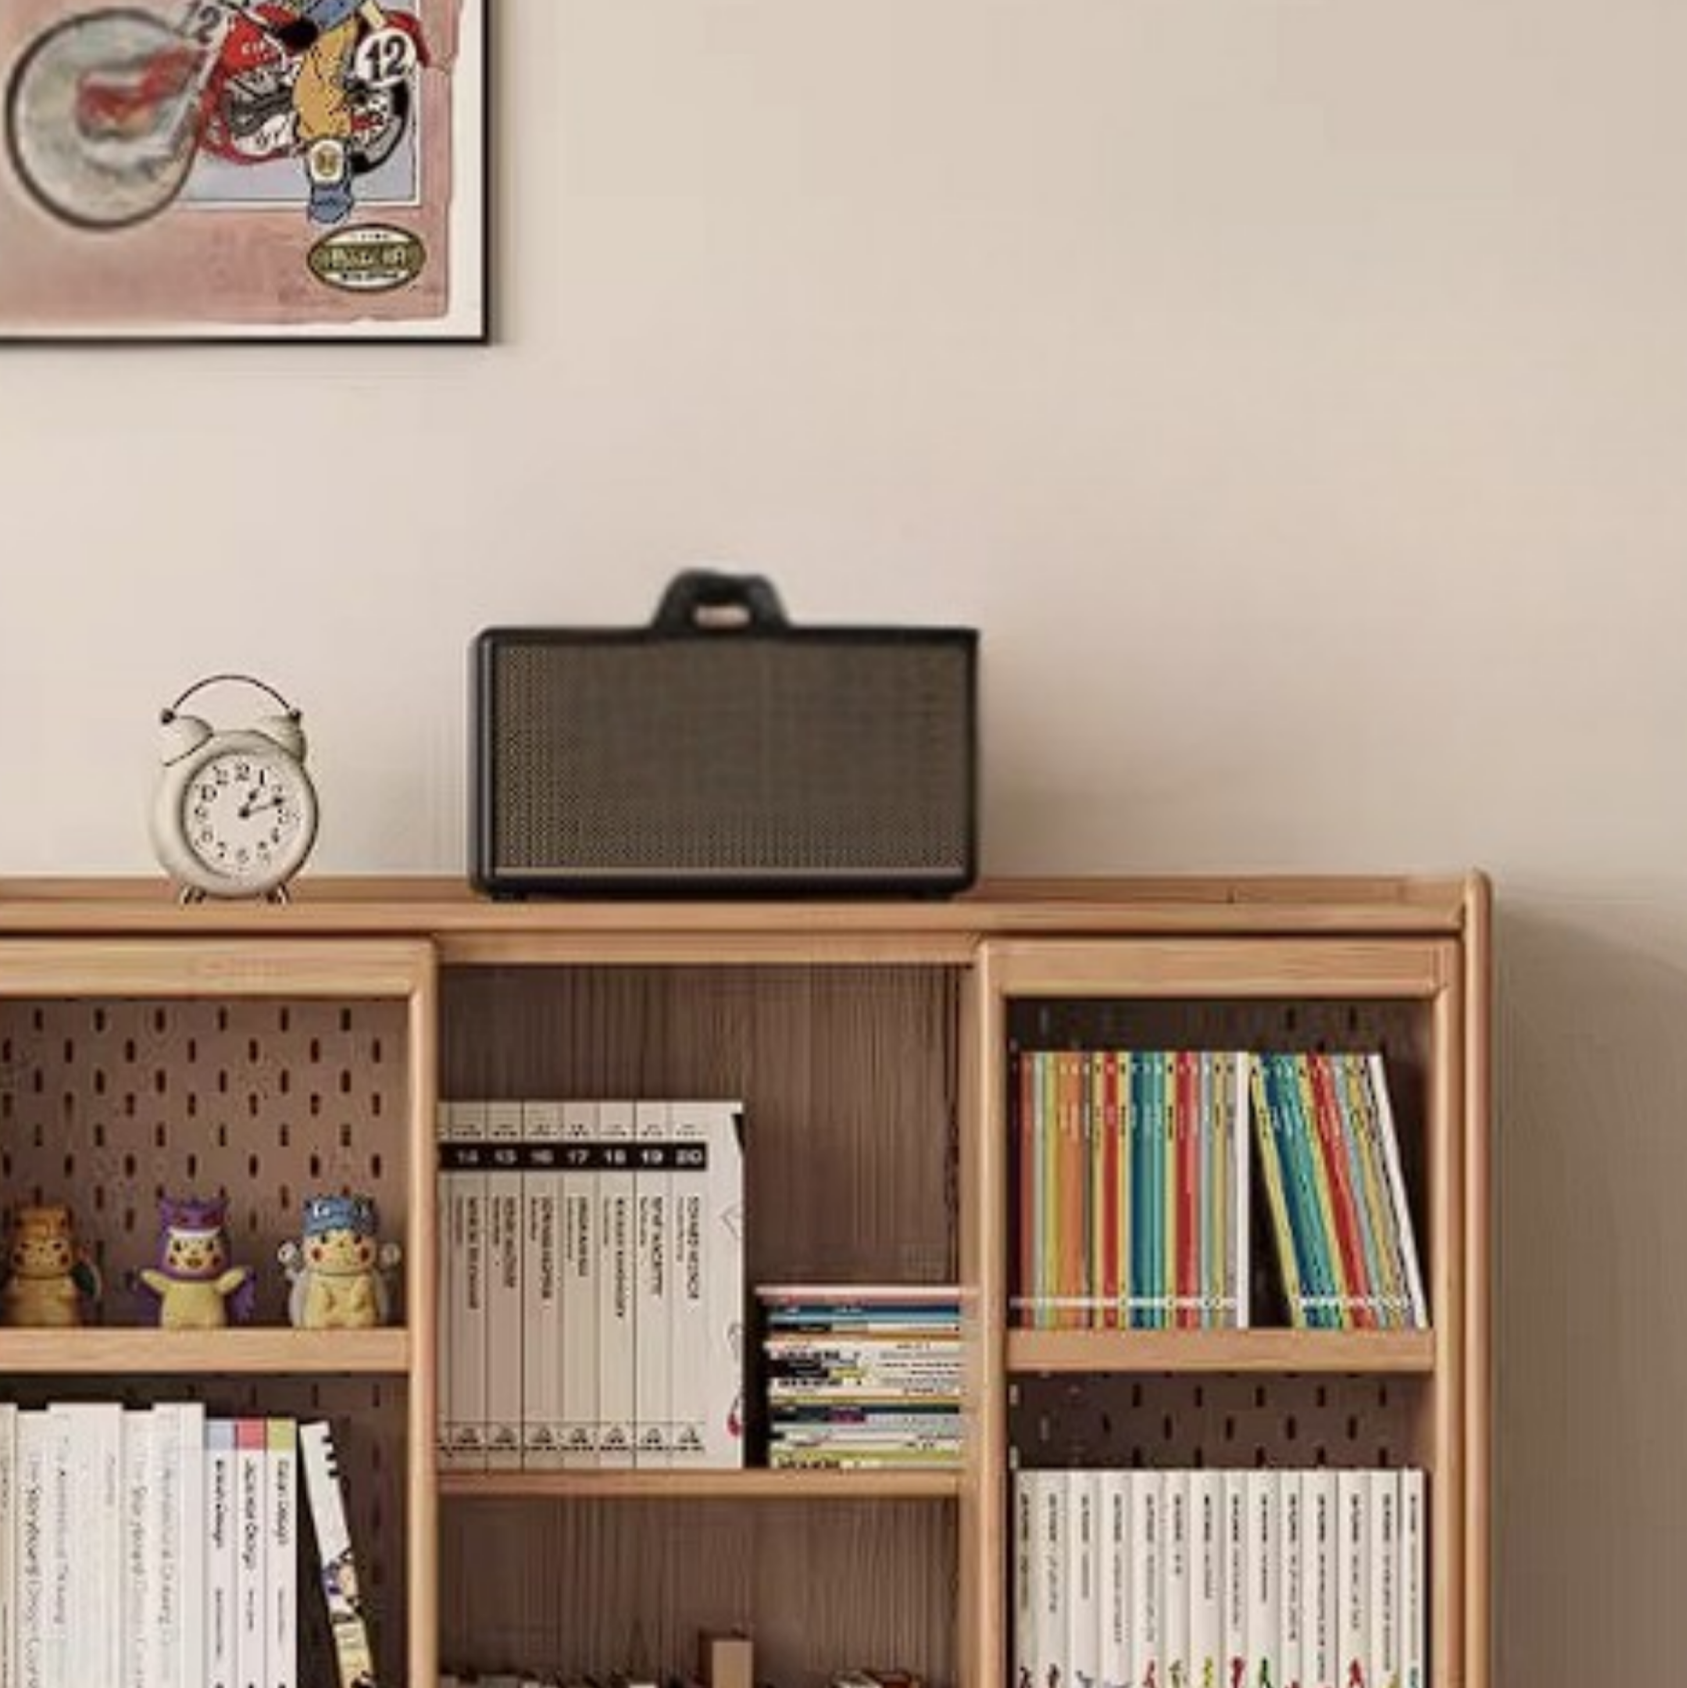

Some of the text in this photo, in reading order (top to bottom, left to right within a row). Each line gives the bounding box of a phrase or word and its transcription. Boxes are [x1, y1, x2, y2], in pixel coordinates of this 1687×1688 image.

[365, 35, 407, 82] 12
[567, 1149, 590, 1164] 17
[675, 1149, 703, 1164] 20
[24, 1485, 43, 1576] Storyboard
